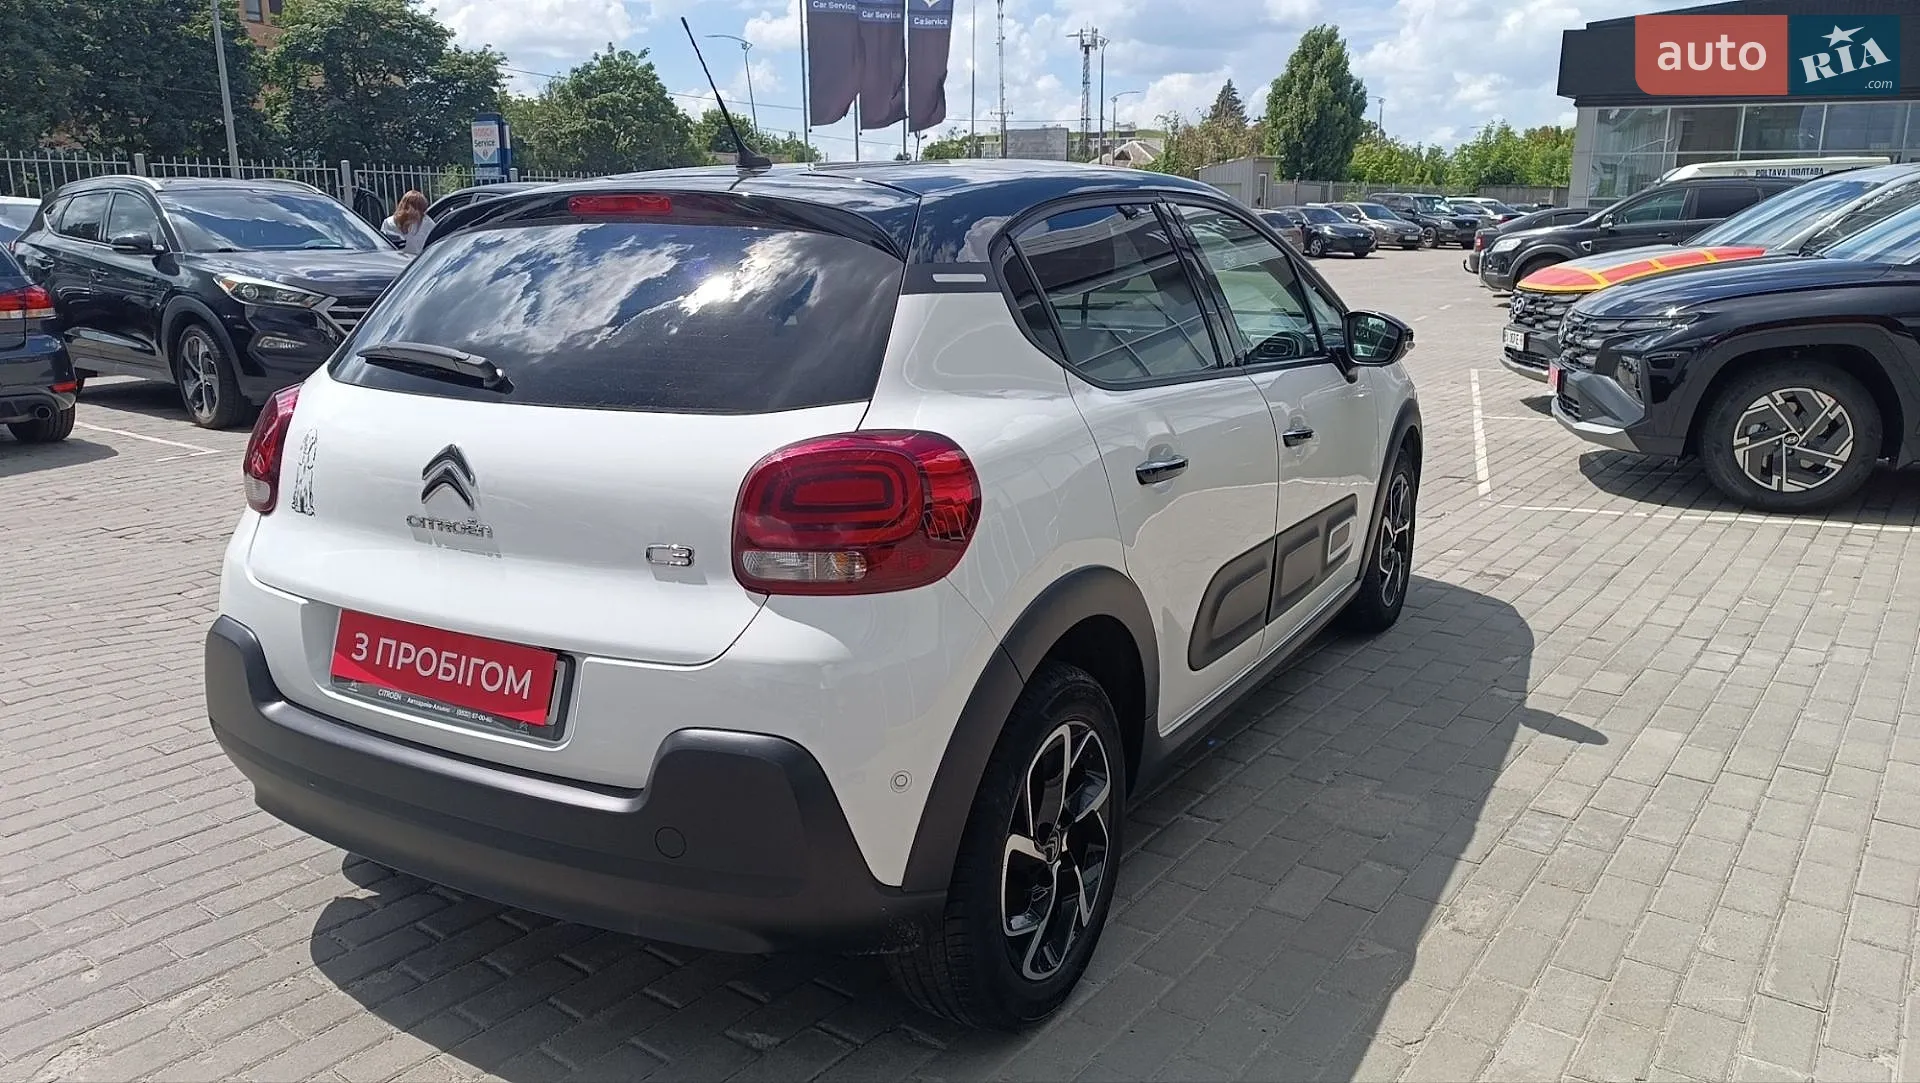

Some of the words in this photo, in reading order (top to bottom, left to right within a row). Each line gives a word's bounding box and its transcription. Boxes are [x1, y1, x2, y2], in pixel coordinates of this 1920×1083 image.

[828, 2, 856, 10] Service
[875, 11, 901, 19] Service
[474, 139, 495, 148] Service
[1755, 168, 1786, 177] POLTAVA
[406, 515, 493, 539] CITROËN
[645, 543, 695, 567] C3
[375, 637, 533, 700] ПРОБІГОМ
